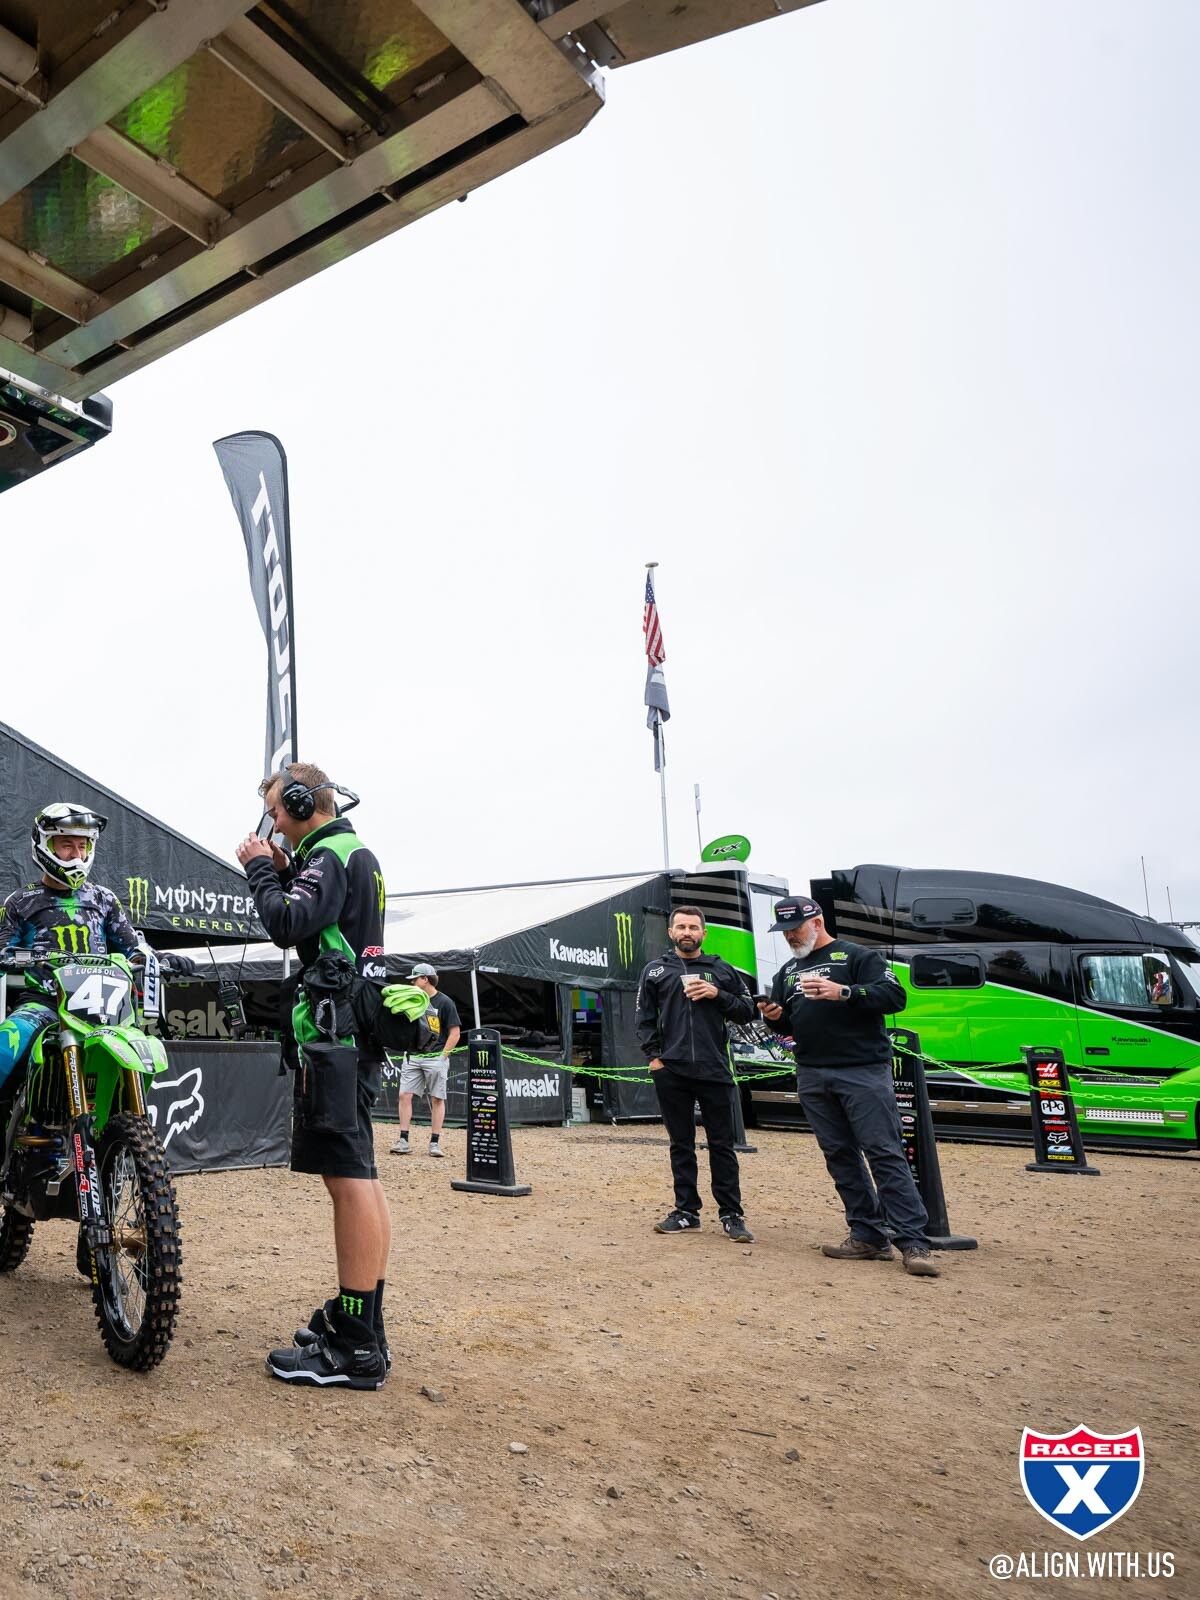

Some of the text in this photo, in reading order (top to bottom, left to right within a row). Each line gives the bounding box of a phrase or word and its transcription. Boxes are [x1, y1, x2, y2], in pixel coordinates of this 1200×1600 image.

[711, 841, 744, 857] KX
[172, 917, 245, 932] ENERGY
[550, 938, 608, 967] Kawasaki
[67, 974, 129, 1016] 47
[504, 1073, 559, 1097] awasaki
[1042, 1101, 1064, 1112] PPG
